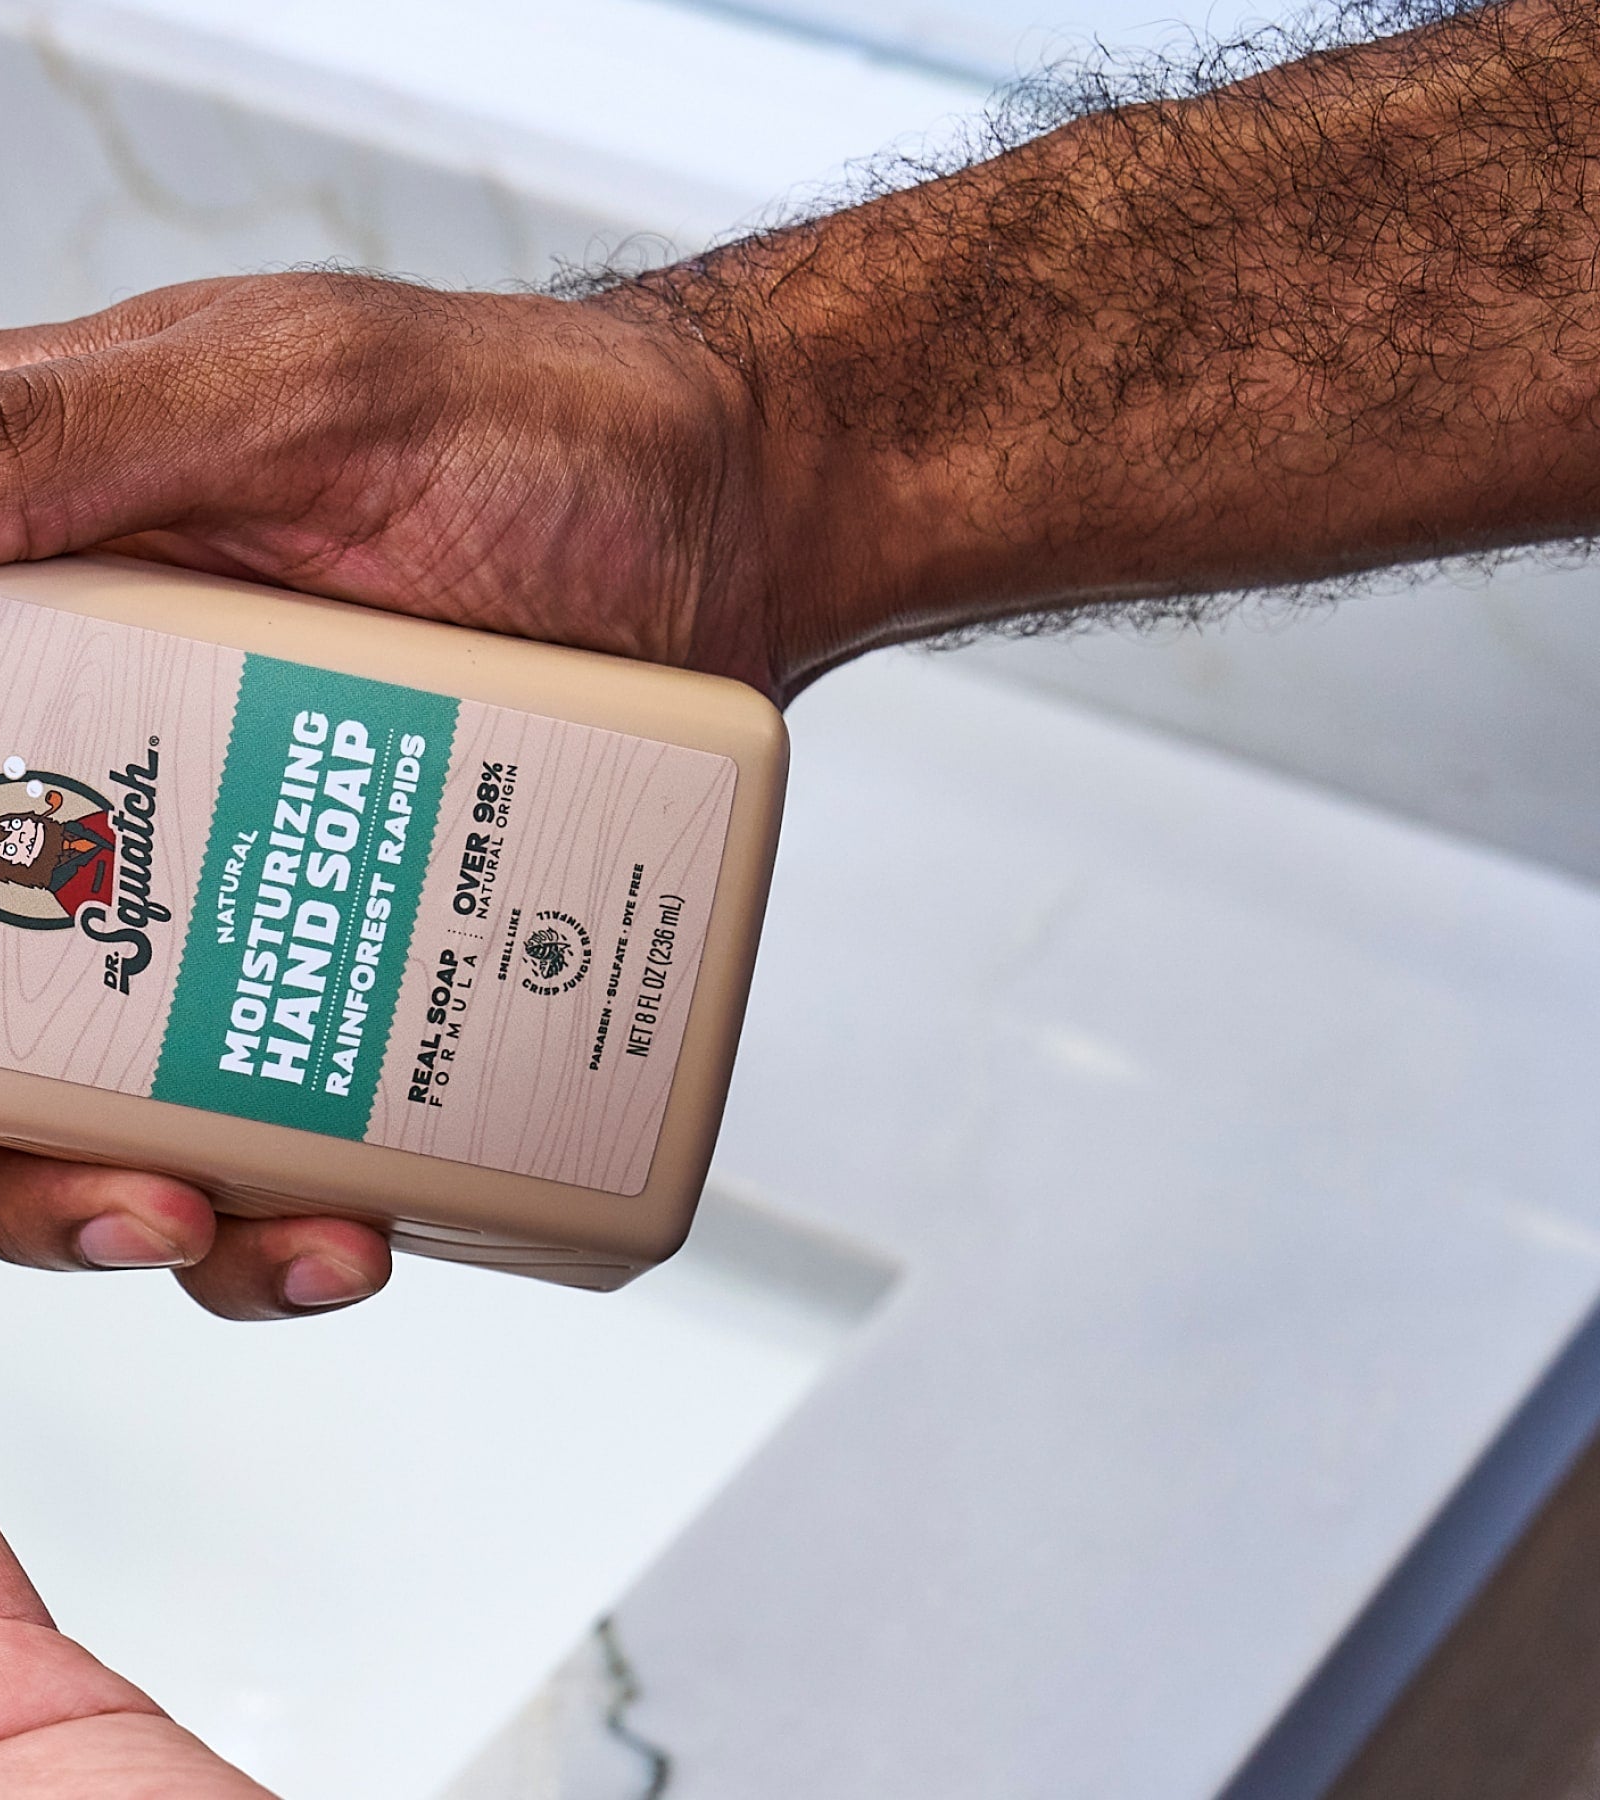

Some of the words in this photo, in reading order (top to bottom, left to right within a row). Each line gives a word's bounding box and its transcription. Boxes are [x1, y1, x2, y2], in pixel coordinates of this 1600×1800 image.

[452, 832, 491, 916] OVER
[472, 760, 503, 824] 98%
[475, 837, 504, 920] NATURAL
[495, 764, 518, 829] ORIGIN
[80, 748, 172, 996] Squatch
[216, 830, 259, 944] NATURAL
[218, 710, 330, 1076] MOISTURIZING
[628, 863, 644, 898] FREE
[260, 899, 341, 1085] HAND
[305, 719, 376, 892] SOAP
[325, 872, 396, 1097] RAINFOREST
[377, 733, 426, 865] RAPIDS
[622, 899, 637, 927] DYE
[658, 894, 686, 927] mL)
[497, 940, 515, 981] SMELL
[507, 908, 522, 938] LIKE
[535, 910, 591, 947] RAINFALL
[646, 928, 675, 966] (236
[103, 951, 119, 990] DR.
[521, 978, 560, 996] CRISP
[562, 948, 592, 993] JUNGLE
[606, 937, 629, 997] SULFATE
[641, 966, 667, 990] OZ
[407, 1033, 442, 1104] REAL
[426, 949, 459, 1026] SOAP
[634, 1012, 657, 1025] 8
[636, 993, 662, 1011] FL
[428, 955, 478, 1108] FORMULA
[588, 1007, 613, 1071] PARABEN
[625, 1023, 654, 1058] NET
